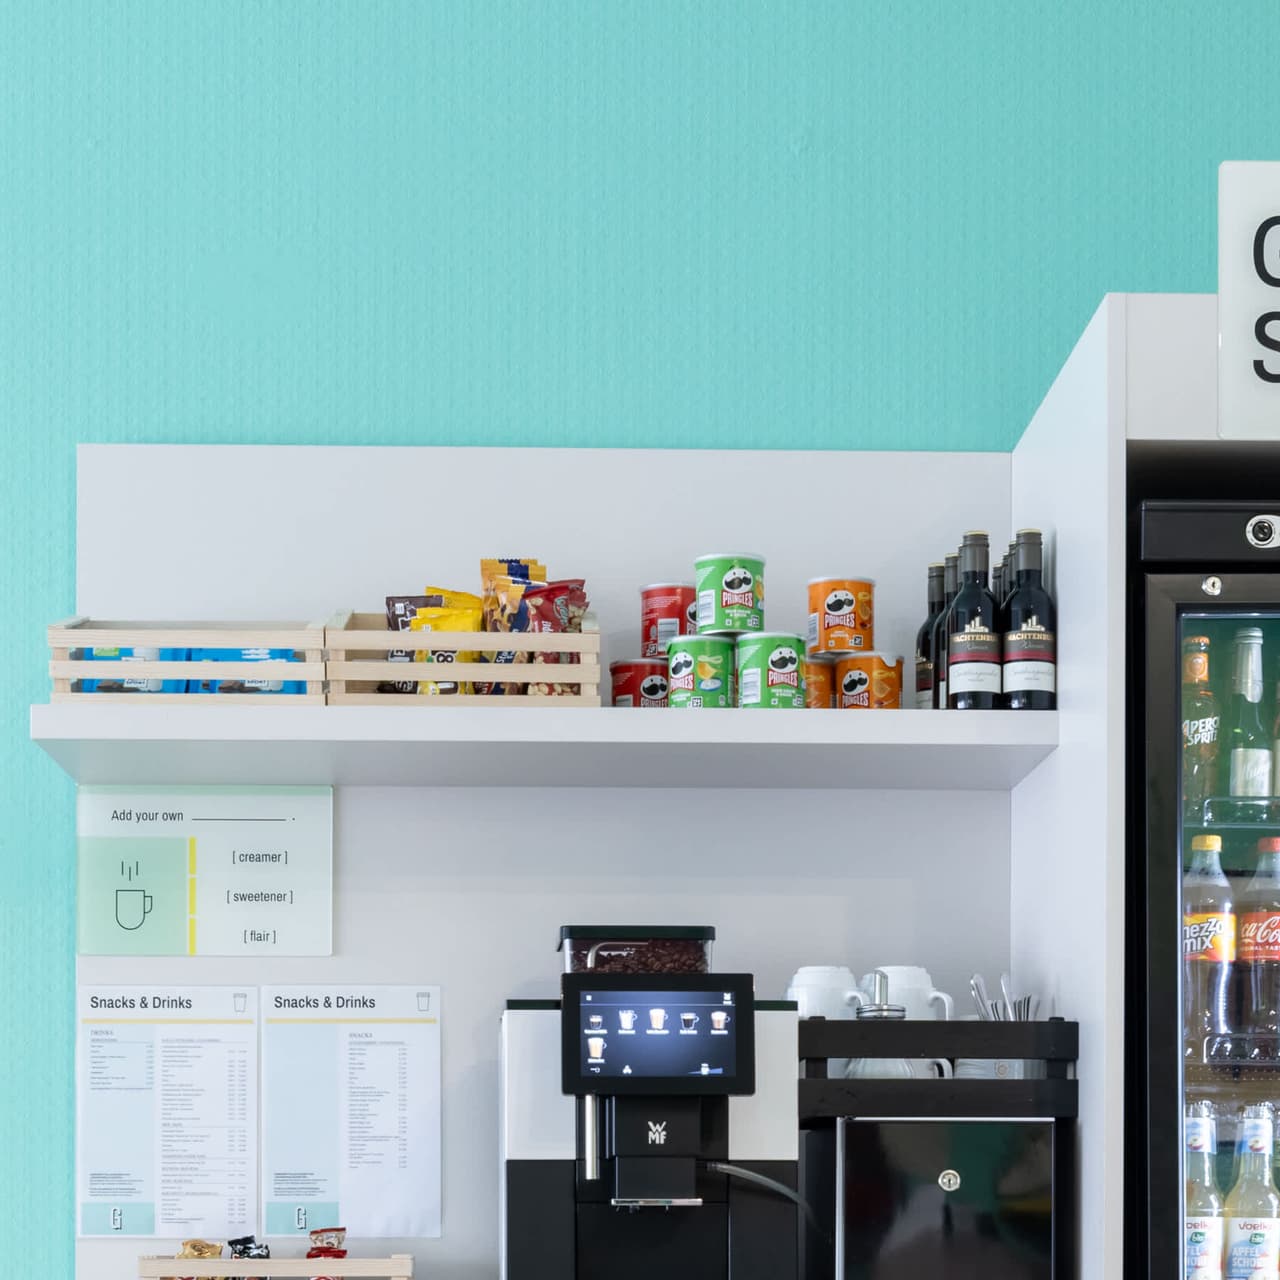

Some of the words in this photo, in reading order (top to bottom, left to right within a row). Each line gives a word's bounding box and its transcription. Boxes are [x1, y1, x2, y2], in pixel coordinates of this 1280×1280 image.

[722, 592, 753, 607] PRINGLES
[824, 614, 855, 628] PRINGLES
[768, 671, 798, 687] PRINGLES
[111, 809, 132, 822] Add
[135, 811, 159, 824] your
[162, 811, 184, 822] own
[239, 851, 282, 863] creamer
[233, 891, 287, 902] sweetener
[250, 930, 270, 942] flair
[90, 995, 136, 1009] Snacks
[139, 996, 149, 1009] &
[152, 995, 193, 1009] Drinks
[274, 995, 319, 1009] Snacks
[323, 996, 332, 1009] &
[336, 995, 376, 1009] Drinks
